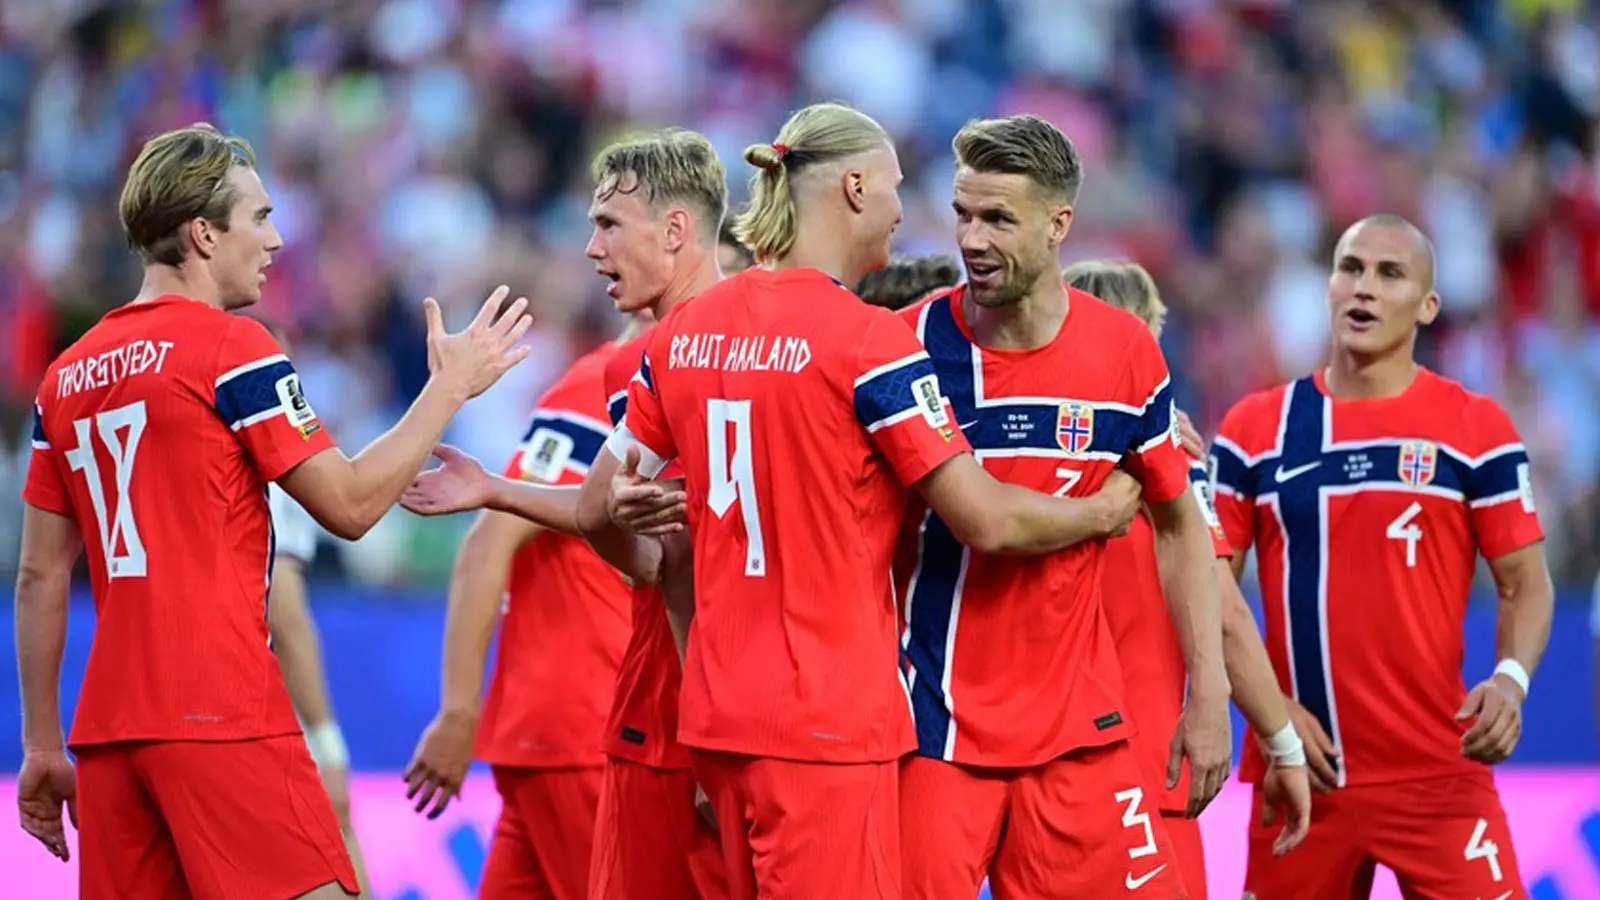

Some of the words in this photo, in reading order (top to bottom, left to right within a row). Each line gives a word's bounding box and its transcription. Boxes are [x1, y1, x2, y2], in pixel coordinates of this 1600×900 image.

[668, 333, 725, 370] BRAUT
[722, 335, 812, 374] HAALAND
[64, 400, 148, 579] 18
[706, 398, 767, 577] 9
[1386, 501, 1423, 568] 4
[1114, 786, 1159, 859] 3
[1464, 817, 1504, 882] 4
